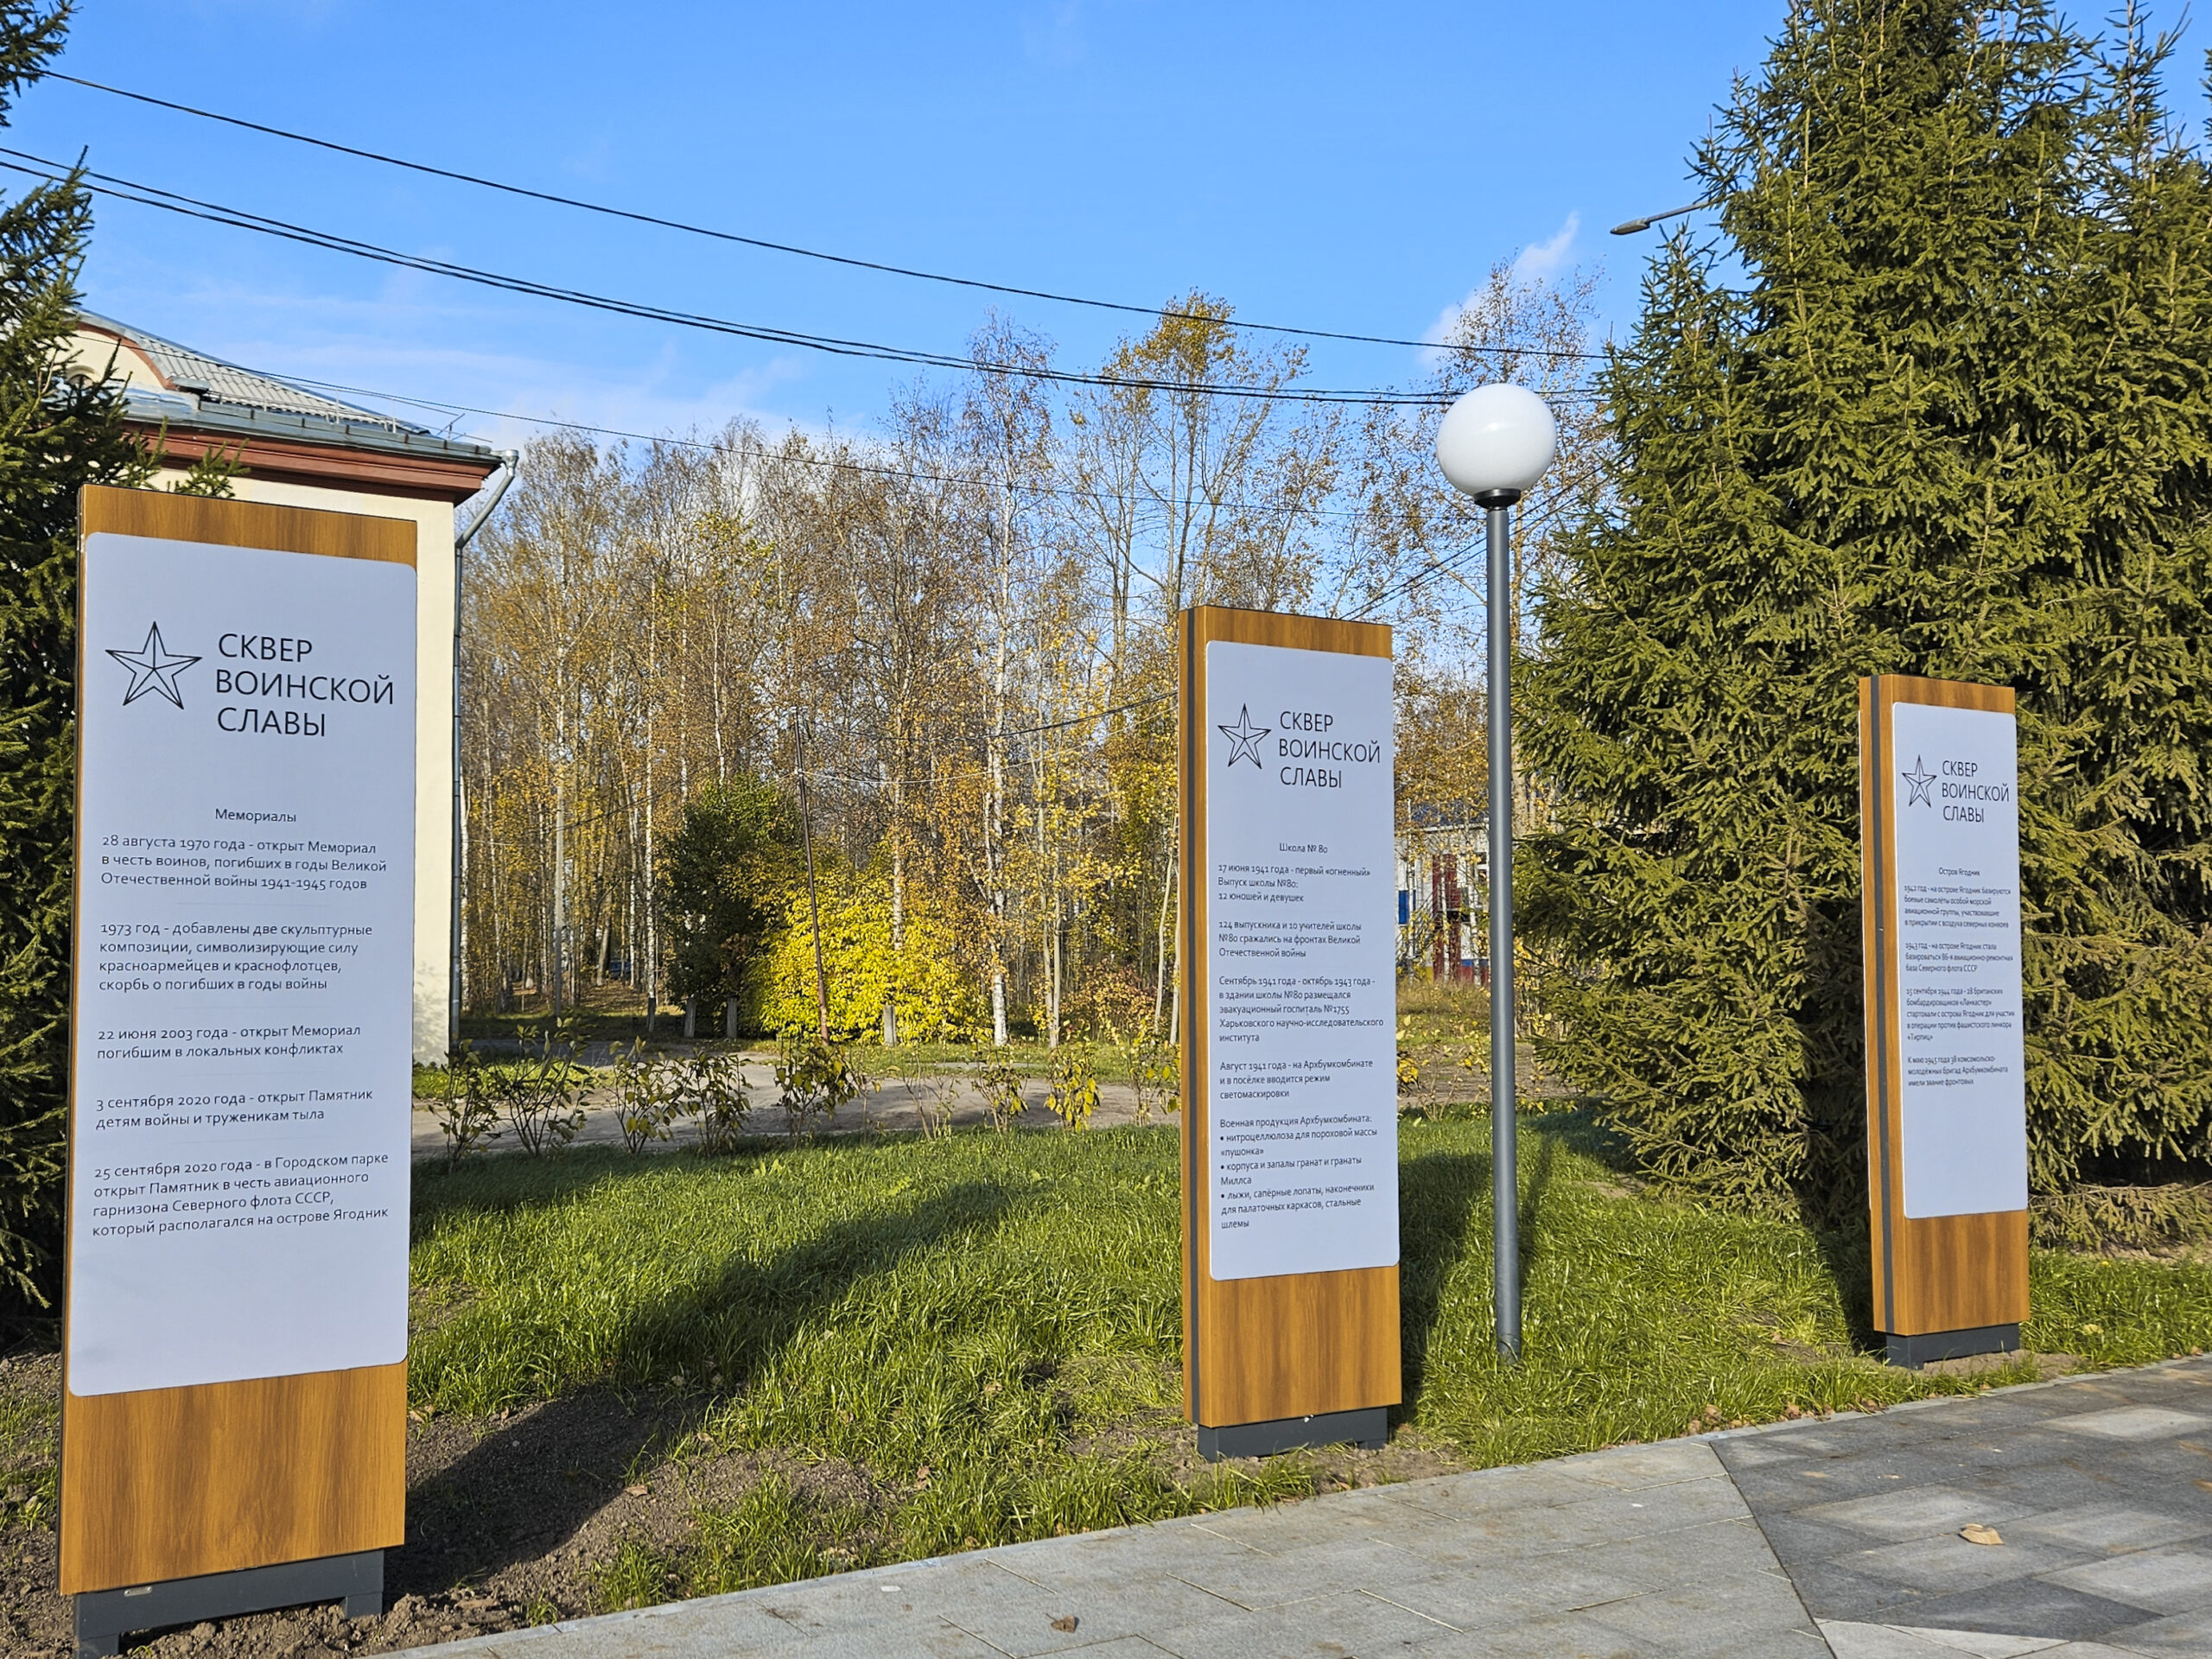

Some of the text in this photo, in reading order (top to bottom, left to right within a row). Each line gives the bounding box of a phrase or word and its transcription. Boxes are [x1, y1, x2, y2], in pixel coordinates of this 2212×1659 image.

[219, 633, 313, 663] СКВЕР
[216, 669, 393, 705] ВОИНСКОЙ
[217, 707, 325, 737] СЛАВЫ
[1280, 710, 1333, 733] СКВЕР
[1279, 738, 1380, 764] ВОИНСКОЙ
[1280, 766, 1342, 788] СЛАВЫ
[1942, 760, 1978, 778] СКВЕР
[1942, 782, 2010, 802] ВОИНСКОЙ
[215, 808, 296, 824] Мемориалы
[1942, 805, 1985, 823] СЛАВЫ
[103, 835, 376, 856] 28 августа 1970 года открыт Мемориал
[1279, 842, 1306, 853] Школа
[1319, 844, 1328, 854] 80
[113, 856, 386, 873] честь воинов, погибших годы Великой
[1251, 866, 1269, 874] 1941
[1295, 866, 1324, 876] первый
[1938, 867, 1980, 877] Остров Ягодник
[101, 872, 367, 891] Отечественной войны 1941-1945 годов
[1218, 876, 1248, 888] Выпуск
[1230, 892, 1304, 904] юношей девушек
[1959, 886, 1981, 894] Ягодник
[100, 921, 372, 938] 1973 год добавлены две скульптурные
[1218, 921, 1232, 930] 124
[1234, 921, 1281, 931] выпускника
[1299, 921, 1335, 932] учителей
[1239, 936, 1281, 945] сражались
[1294, 934, 1326, 946] фронтах
[1328, 935, 1361, 944] Великой
[1960, 942, 1982, 950] Ягодник
[100, 944, 359, 957] композиции, символизирующие силу
[1219, 947, 1306, 957] Отечественной войны
[99, 959, 341, 975] красноармейцев краснофлотцев,
[99, 977, 327, 994] скорбь погибших годы войны
[1219, 976, 1352, 988] Сентябрь 1941 октябрь 1943
[1225, 992, 1255, 1001] здании
[1304, 992, 1351, 1001] размещался
[1219, 1004, 1281, 1016] эвакуационный
[1283, 1006, 1322, 1014] госпиталь
[1219, 1019, 1384, 1030] Харьковского научно-исследовательского
[99, 1025, 360, 1041] 22 июня 2003 года открыт Мемориал
[1219, 1034, 1260, 1044] института
[97, 1042, 343, 1059] погибшим локальных конфликтах
[1219, 1058, 1373, 1073] Август Архбумкомбинате
[1233, 1075, 1331, 1085] посёлке вводится режим
[107, 1090, 372, 1110] сентября 2020 года открыт Памятник
[1220, 1090, 1289, 1100] светомаскировки
[96, 1110, 324, 1130] детям войны труженикам тыла
[1220, 1119, 1254, 1128] Военная
[1255, 1118, 1299, 1128] продукция
[1226, 1132, 1294, 1144] нитроцеллюлоза
[1311, 1128, 1353, 1141] пороховой
[94, 1154, 388, 1180] 25 сентября 2020 года Городском парке
[1226, 1157, 1362, 1173] корпуса запалы гранат гранаты
[94, 1173, 369, 1199] открыт Памятник честь авиационного
[1221, 1176, 1252, 1185] Миллса
[1227, 1185, 1375, 1200] лыжи, сапёрные лопаты, наконечники
[93, 1192, 334, 1219] гарнизона Северного флота СССР,
[1238, 1198, 1362, 1213] палаточных каркасов, стальные
[92, 1209, 388, 1238] который располагался на острове Ягодник
[1221, 1220, 1249, 1229] шлемы
